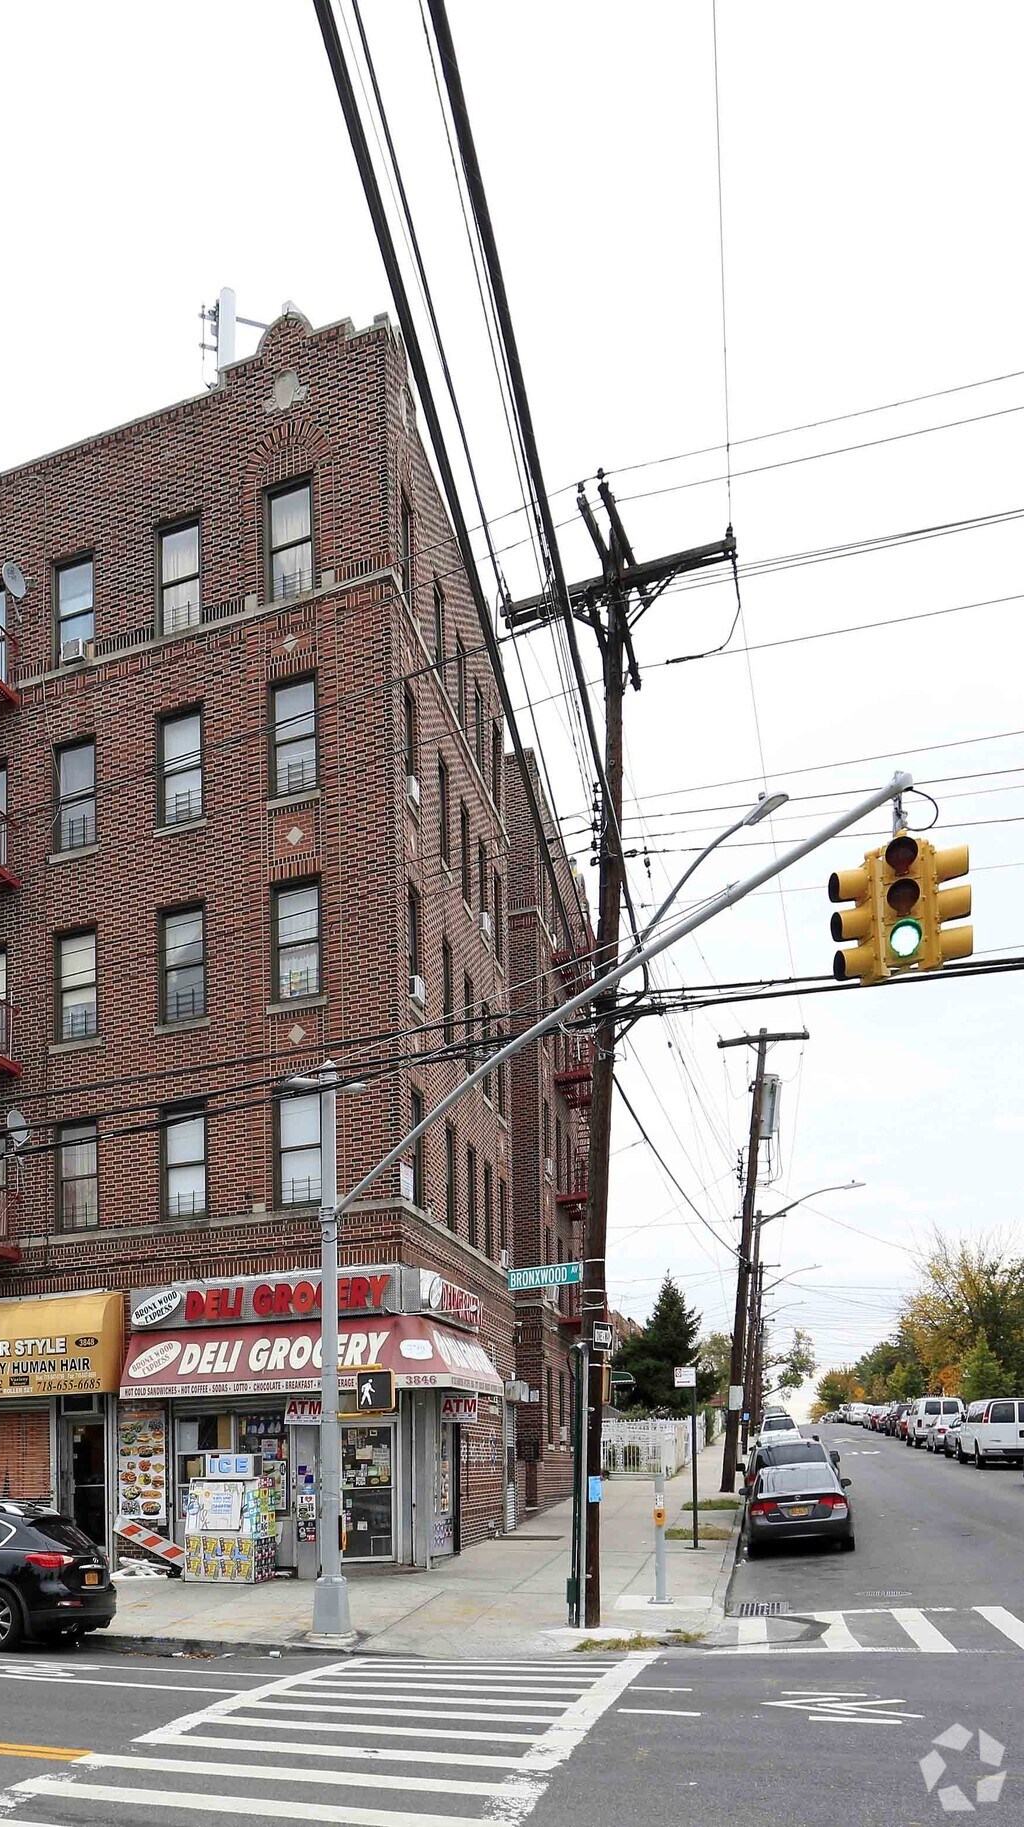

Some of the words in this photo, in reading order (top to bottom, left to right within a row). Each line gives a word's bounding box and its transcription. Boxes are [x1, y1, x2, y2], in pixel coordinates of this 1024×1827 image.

[510, 1268, 568, 1288] BRONXWOOD
[570, 1265, 578, 1274] AV
[134, 1302, 157, 1319] BRONX
[158, 1290, 178, 1305] WOOD
[144, 1302, 173, 1324] EXPRESS
[184, 1287, 244, 1321] DELI
[14, 1337, 68, 1356] STYLE
[60, 1358, 90, 1372] HAIR
[131, 1354, 154, 1372] BRONX
[154, 1342, 174, 1357] WOOD
[142, 1354, 170, 1376] EXPRESS
[177, 1340, 243, 1375] DELI
[36, 1378, 101, 1392] 718-655-6685
[125, 1387, 134, 1396] HOT
[134, 1386, 146, 1396] COLD
[147, 1385, 178, 1396] SANDWICHES
[181, 1385, 190, 1395] HOT
[191, 1384, 208, 1394] COFFEE
[212, 1384, 228, 1393] SODAS
[233, 1383, 248, 1393] LOTTO
[253, 1381, 281, 1391] CHOCOLATE
[285, 1379, 314, 1390] BREAKFAST
[405, 1375, 437, 1386] 3846
[287, 1400, 322, 1415] ATM
[442, 1398, 477, 1413] ATM
[209, 1457, 249, 1474] ICE
